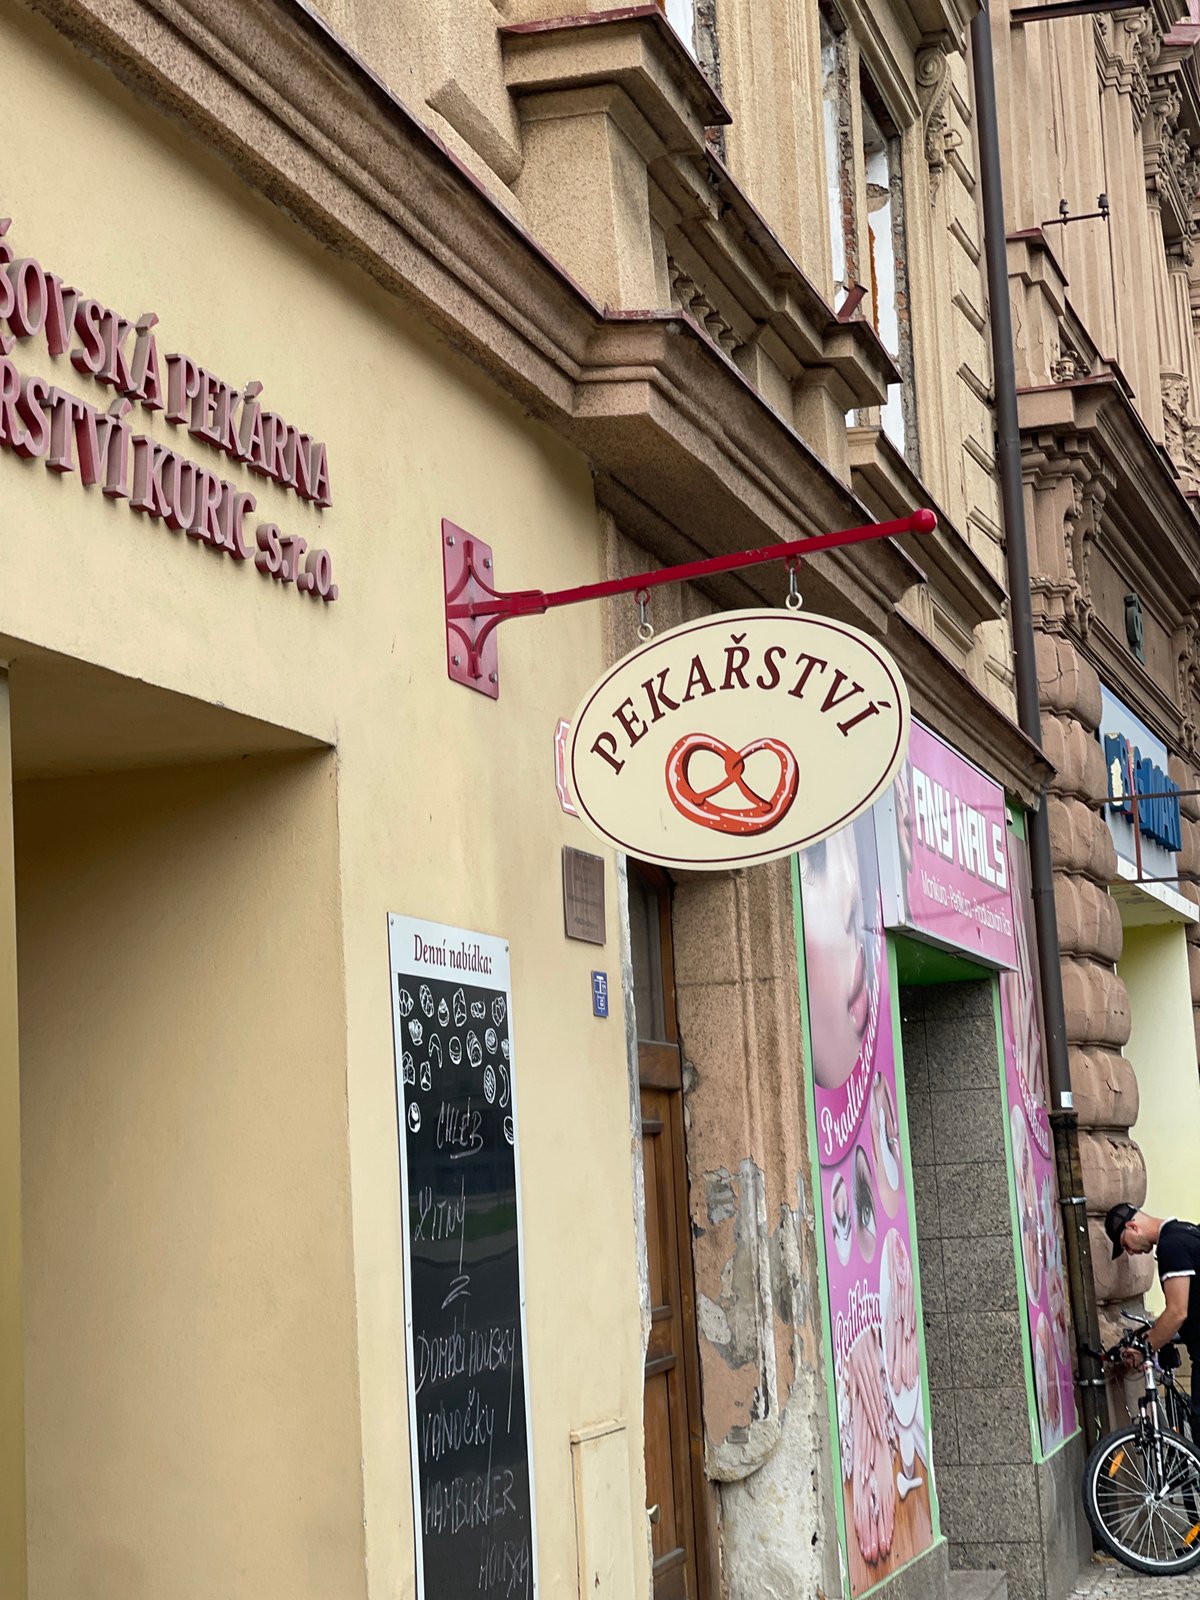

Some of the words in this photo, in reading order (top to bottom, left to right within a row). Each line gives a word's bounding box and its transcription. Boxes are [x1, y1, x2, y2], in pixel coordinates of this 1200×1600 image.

[164, 353, 332, 508] PEKÁRNA
[130, 434, 257, 559] KURIC
[255, 523, 338, 601] s.r.o.
[590, 633, 891, 775] PEKAŘSTVÍ
[912, 766, 953, 861] ANY
[954, 794, 1007, 890] NAILS
[414, 934, 446, 966] Denní
[449, 942, 492, 975] nabídka:
